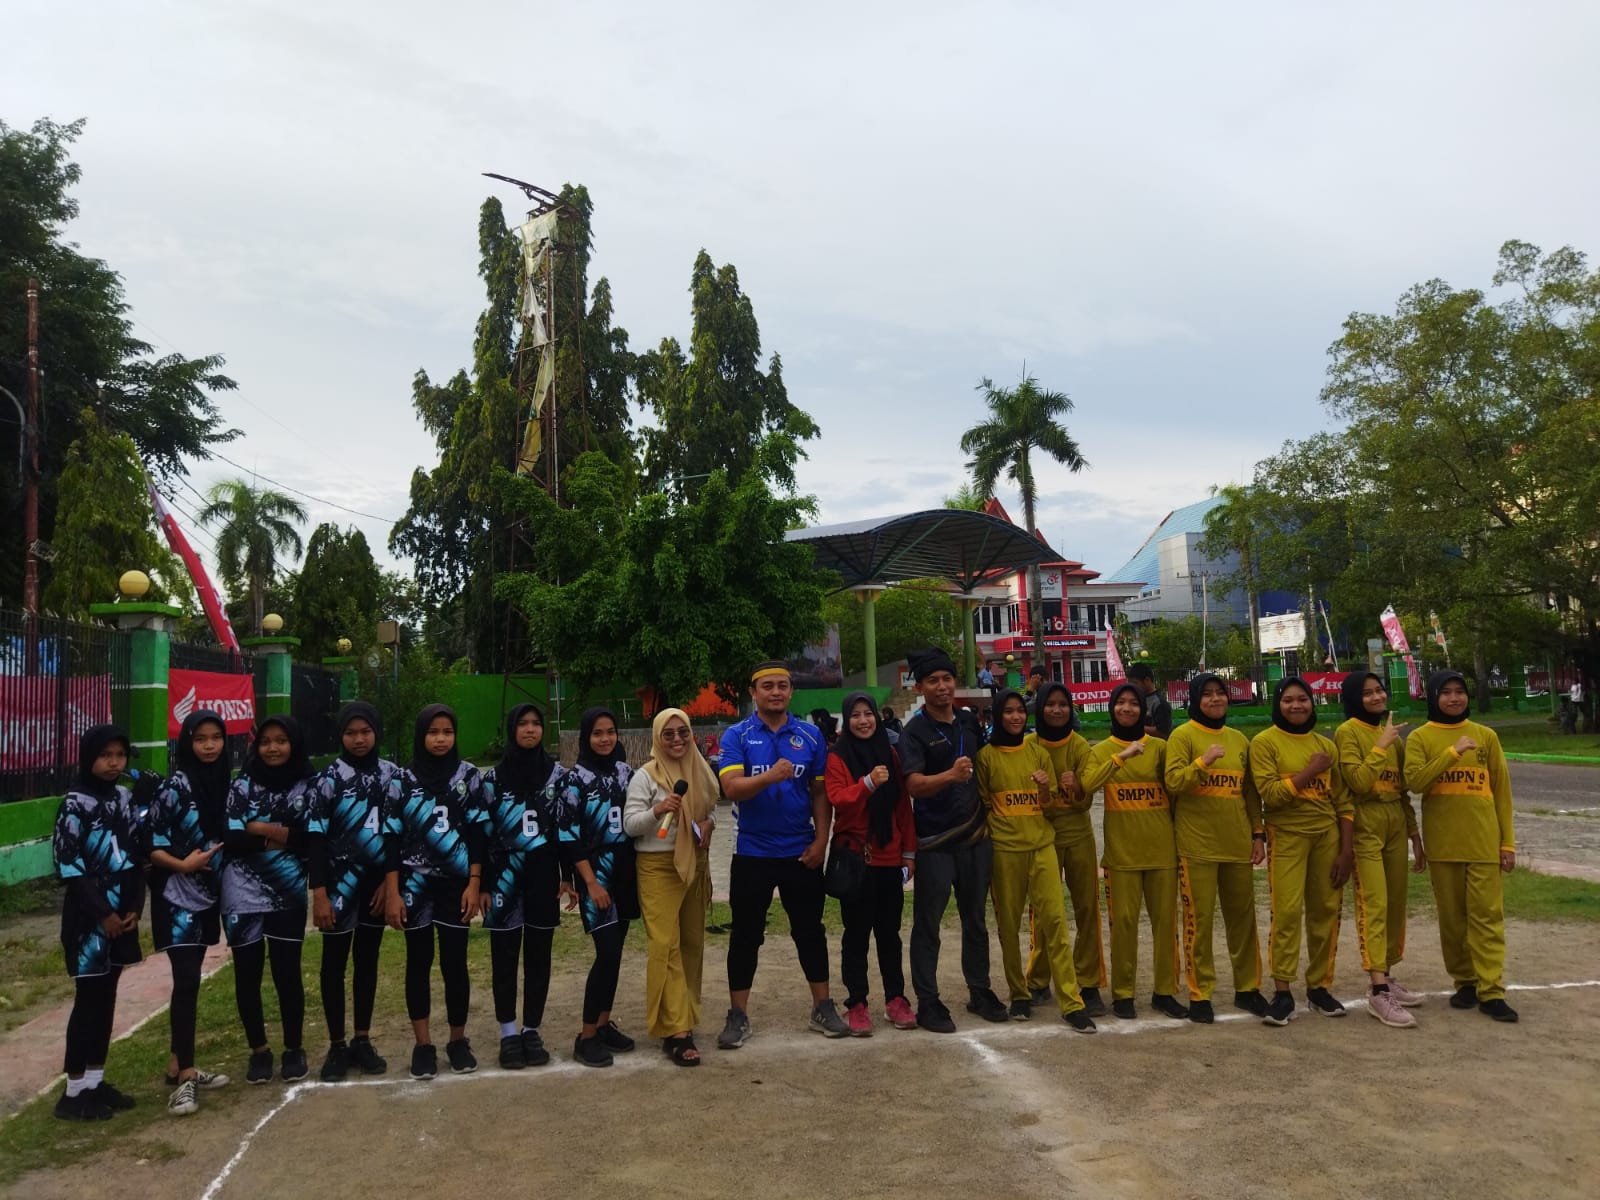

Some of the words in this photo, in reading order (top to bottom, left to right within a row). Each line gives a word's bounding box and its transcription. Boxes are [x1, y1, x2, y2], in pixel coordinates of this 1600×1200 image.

[1071, 690, 1113, 701] HOND
[197, 699, 255, 721] HONDA
[1006, 793, 1038, 806] SMPN
[1118, 788, 1155, 801] SMPN
[363, 805, 380, 834] 4
[432, 805, 449, 833] 3
[522, 809, 539, 837] 6
[607, 805, 622, 834] 9
[111, 834, 123, 864] 1
[335, 895, 344, 911] 4
[404, 892, 413, 907] 3
[495, 893, 504, 908] 6
